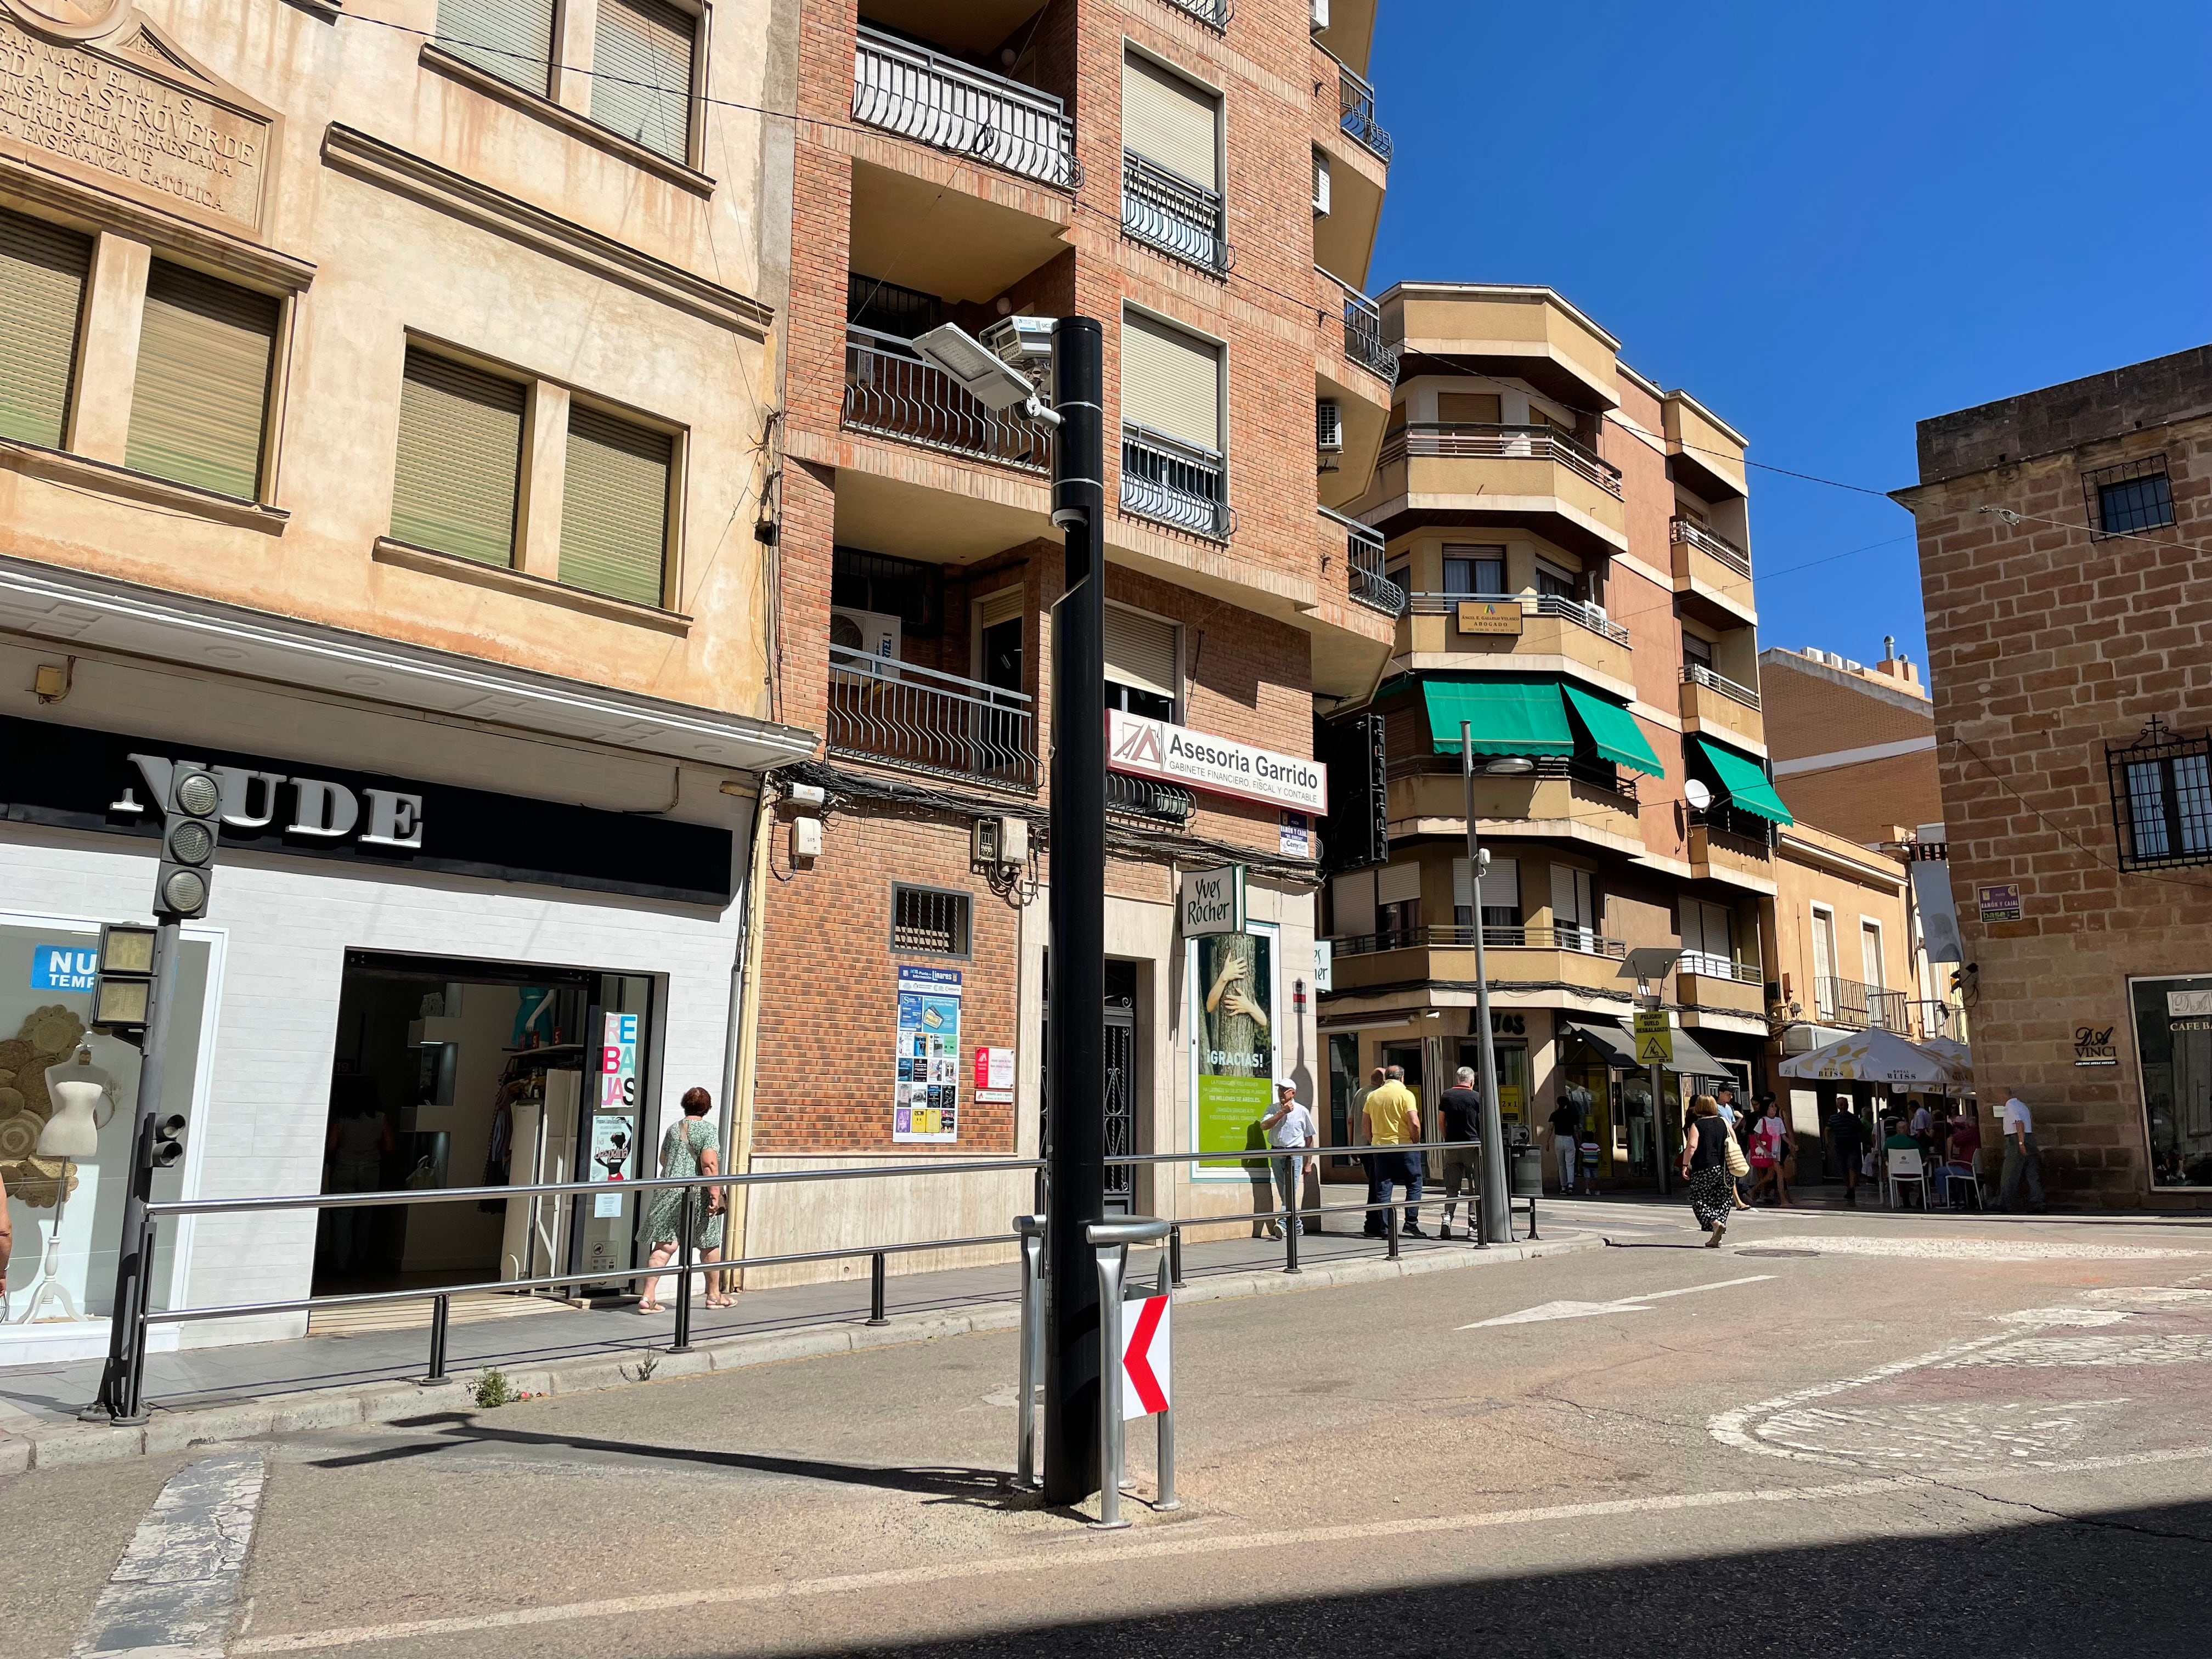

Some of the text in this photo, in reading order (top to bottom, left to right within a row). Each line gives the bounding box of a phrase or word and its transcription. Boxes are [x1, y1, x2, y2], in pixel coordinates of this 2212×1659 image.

[136, 38, 160, 59] 1936
[43, 45, 100, 80] NACIÓ
[106, 70, 128, 93] EL
[136, 80, 154, 103] M.
[179, 98, 194, 119] S.
[2, 74, 233, 178] INSTITUCIÓN TERESIANA
[57, 70, 255, 167] CASTROVERDE
[139, 168, 225, 212] CATÓLICA
[1169, 733, 1318, 789] Asesoria Garrido
[1169, 760, 1205, 777] GABINETE
[1207, 769, 1251, 789] FINANCIERO,
[1253, 780, 1276, 794] FISCAL
[1283, 787, 1317, 804] CONTABLE
[1195, 878, 1221, 905] Yves
[1981, 900, 1997, 909] RAMÓN
[1187, 900, 1230, 926] Rocher
[932, 970, 952, 981] Linares
[603, 1015, 636, 1044] RE
[2170, 1022, 2212, 1031] CAFE B
[601, 1046, 635, 1075] BA
[1206, 1048, 1263, 1068] ¡GRACIAS!
[2074, 1046, 2117, 1058] VINCI
[601, 1077, 635, 1106] JAS
